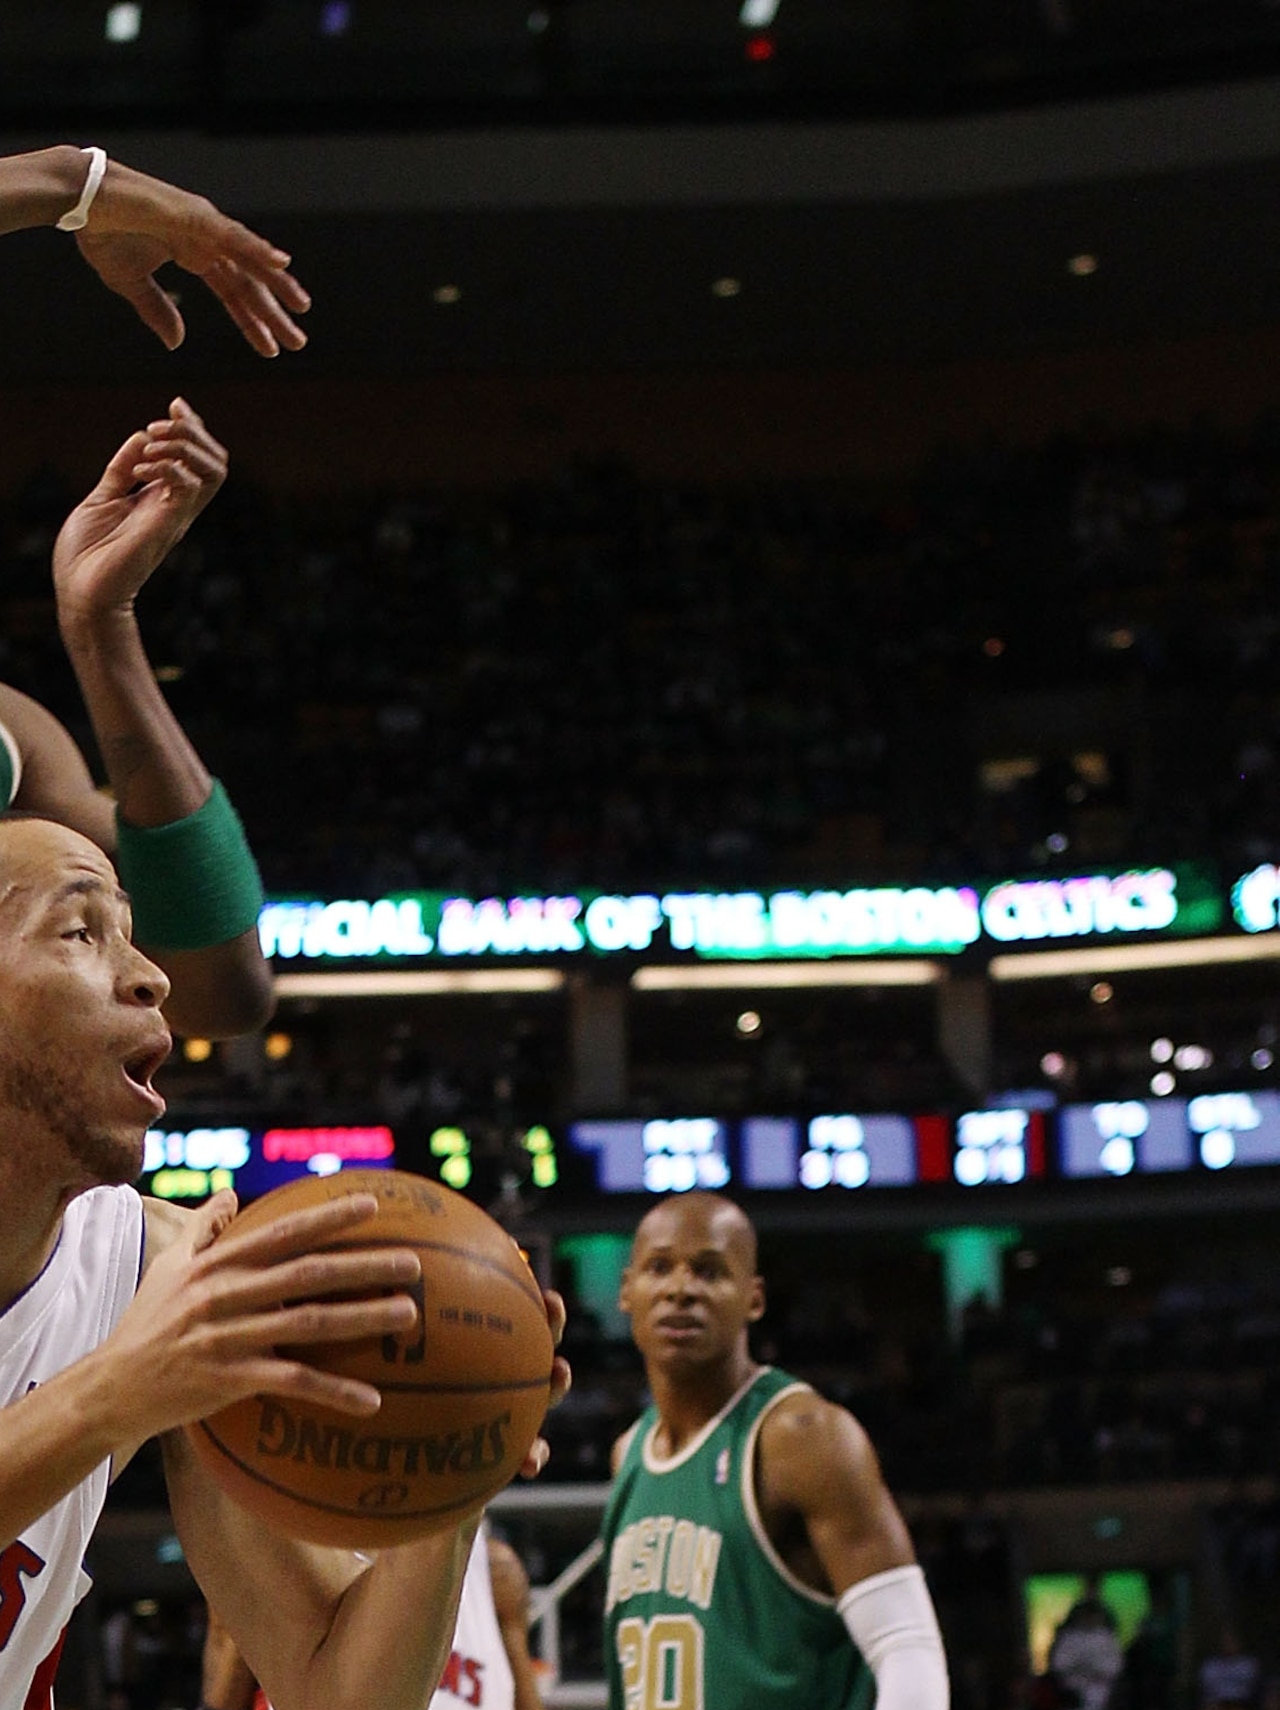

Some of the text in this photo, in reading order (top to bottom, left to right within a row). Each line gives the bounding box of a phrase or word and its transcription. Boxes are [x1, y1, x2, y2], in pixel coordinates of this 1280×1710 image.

[257, 898, 434, 959] FFICIAL
[437, 896, 586, 955] BANK
[585, 895, 663, 952] OF
[661, 891, 765, 950] THE
[769, 887, 982, 947] BOSTON
[981, 868, 1178, 942] CELTICS
[255, 1394, 511, 1476] SPALDING
